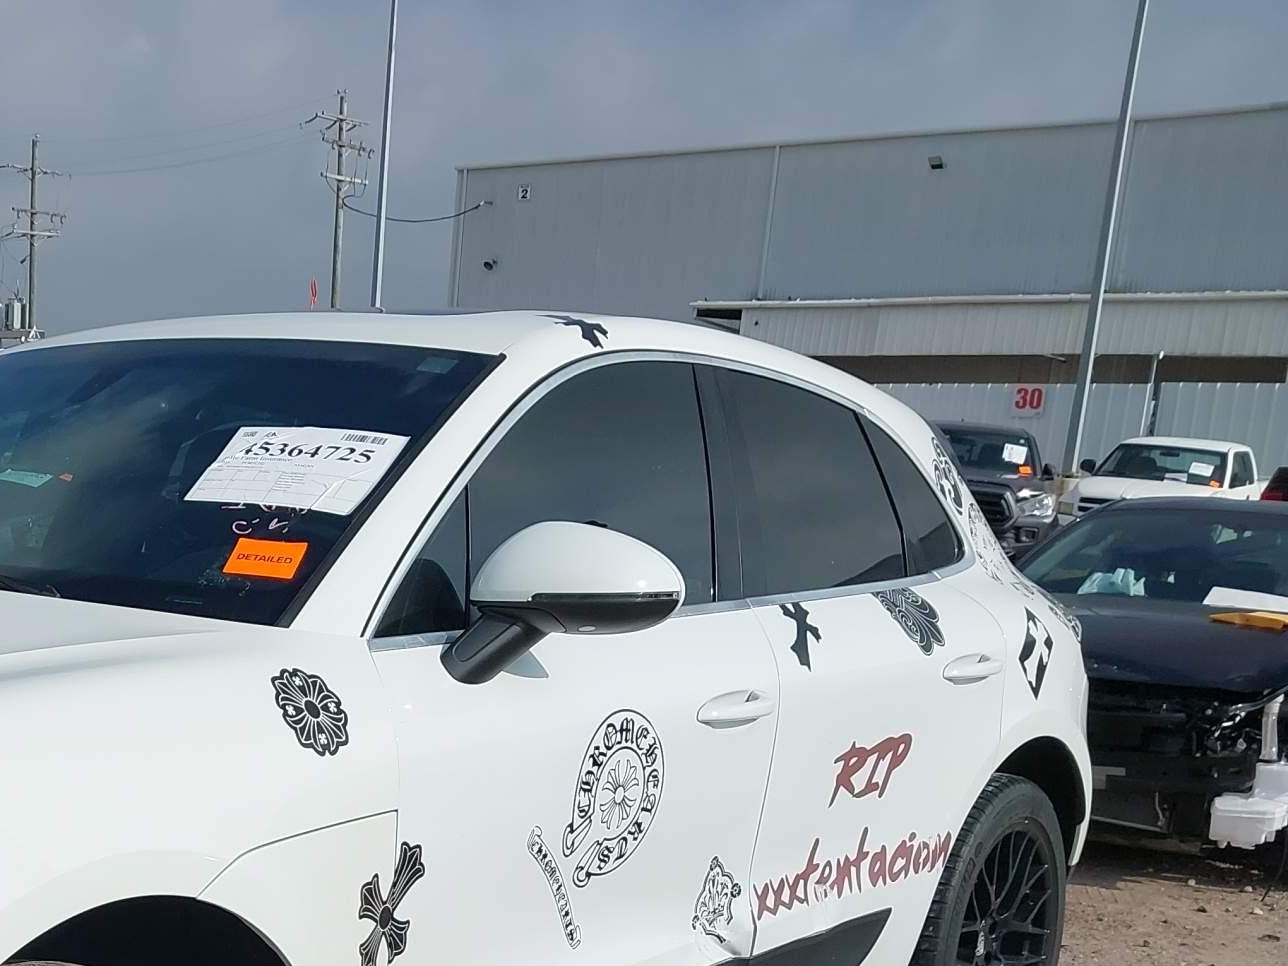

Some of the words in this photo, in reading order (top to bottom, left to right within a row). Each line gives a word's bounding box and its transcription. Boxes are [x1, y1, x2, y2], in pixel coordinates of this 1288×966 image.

[520, 188, 529, 199] 2
[1015, 387, 1043, 409] 30
[239, 441, 376, 464] 45364725
[236, 553, 293, 564] DETAILED
[828, 733, 912, 808] RIP
